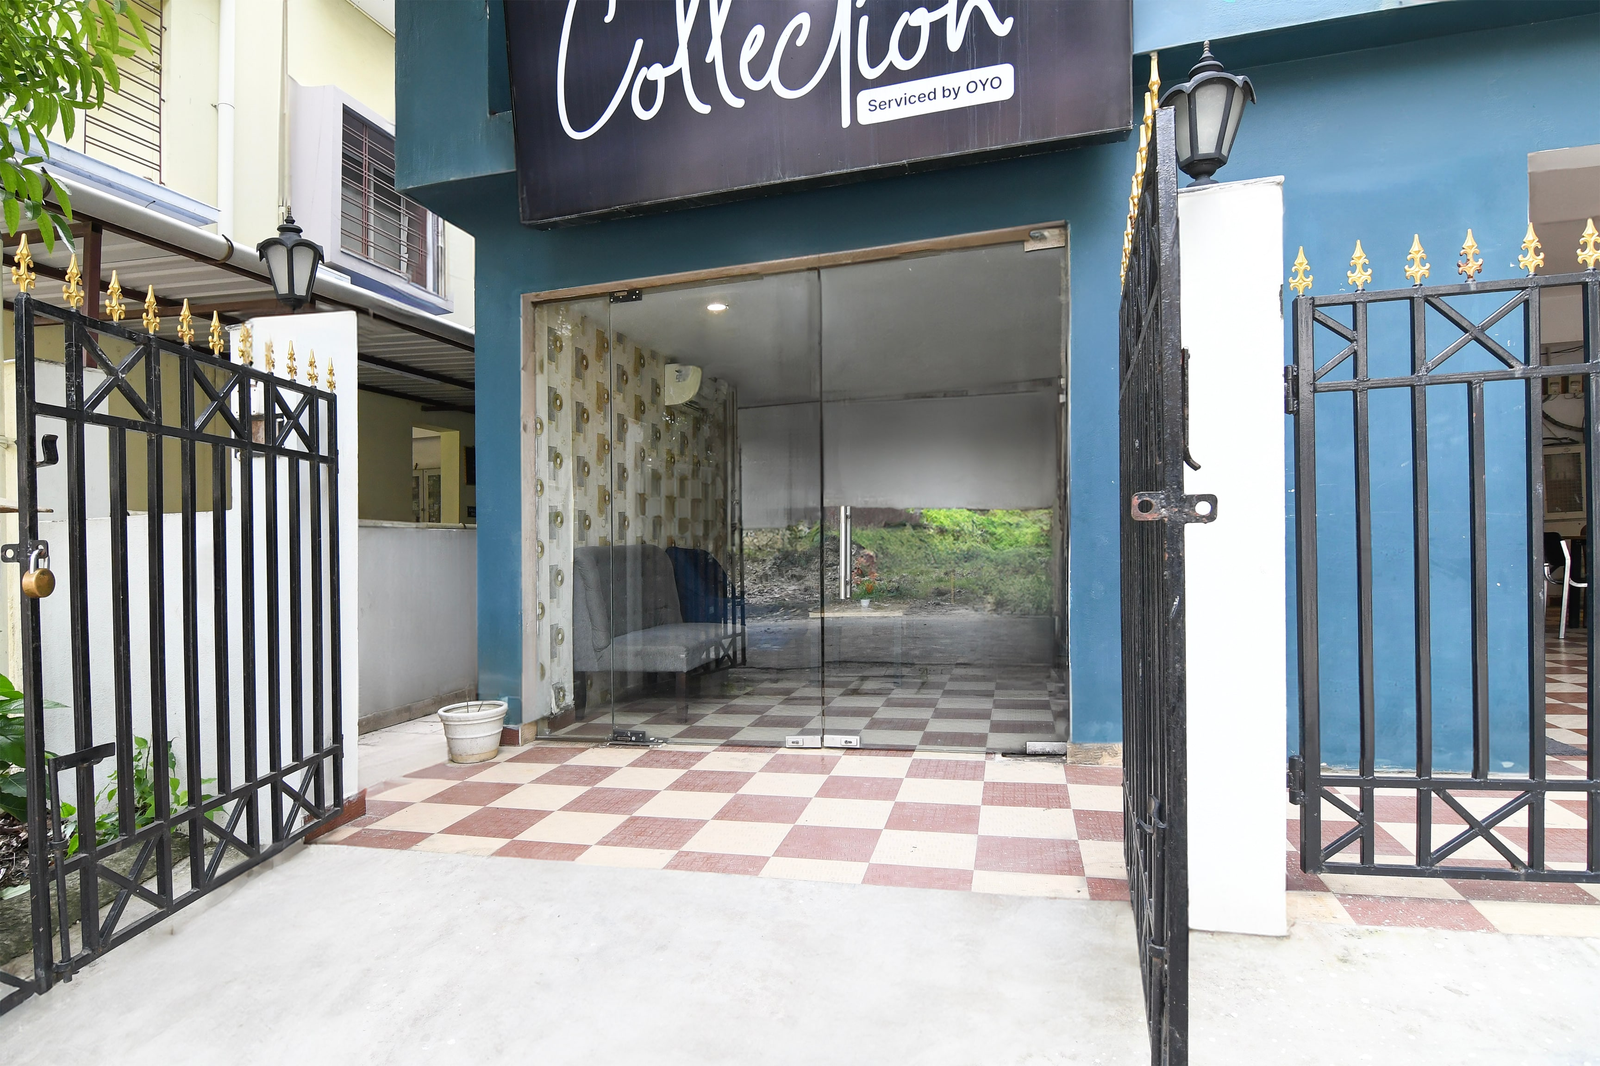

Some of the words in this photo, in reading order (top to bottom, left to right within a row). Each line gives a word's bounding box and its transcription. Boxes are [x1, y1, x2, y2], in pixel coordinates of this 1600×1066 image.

[557, 0, 1014, 140] Collection
[867, 87, 937, 112] Serviced
[942, 85, 961, 100] by
[966, 76, 1002, 94] OYO
